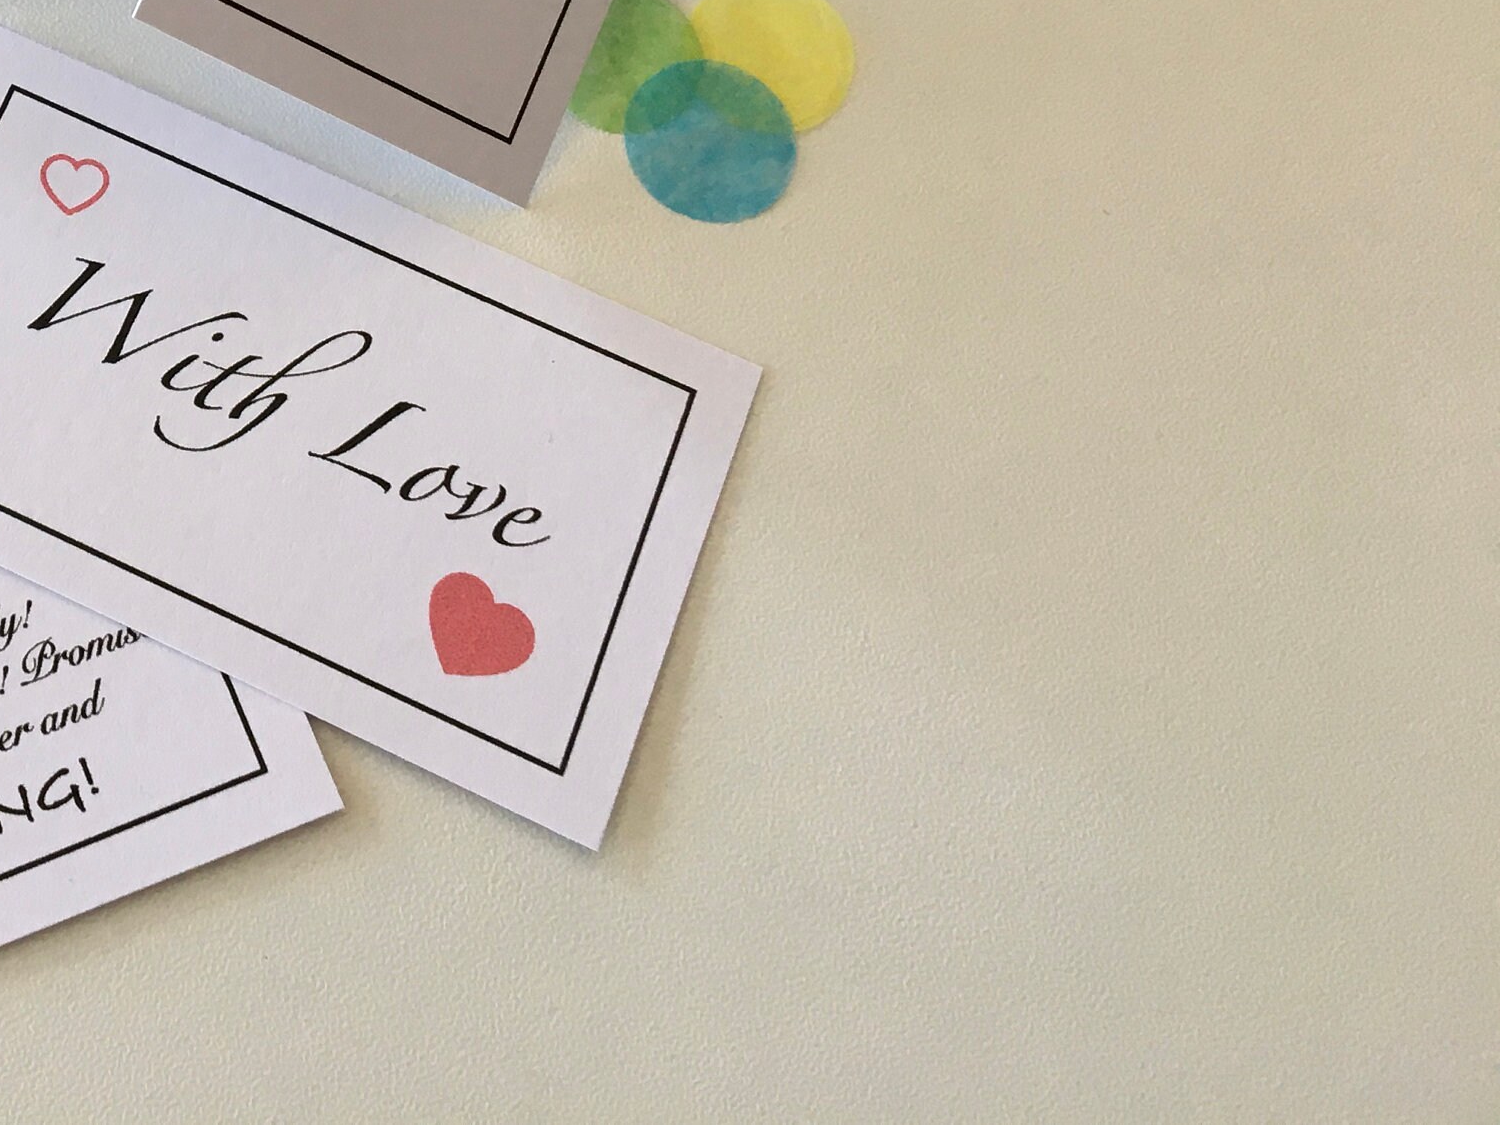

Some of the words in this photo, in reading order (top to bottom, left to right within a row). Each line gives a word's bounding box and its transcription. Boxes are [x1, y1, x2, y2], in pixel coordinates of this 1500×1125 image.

[27, 257, 373, 452] With
[307, 401, 551, 548] Love
[20, 626, 149, 687] Promis
[40, 677, 105, 736] and
